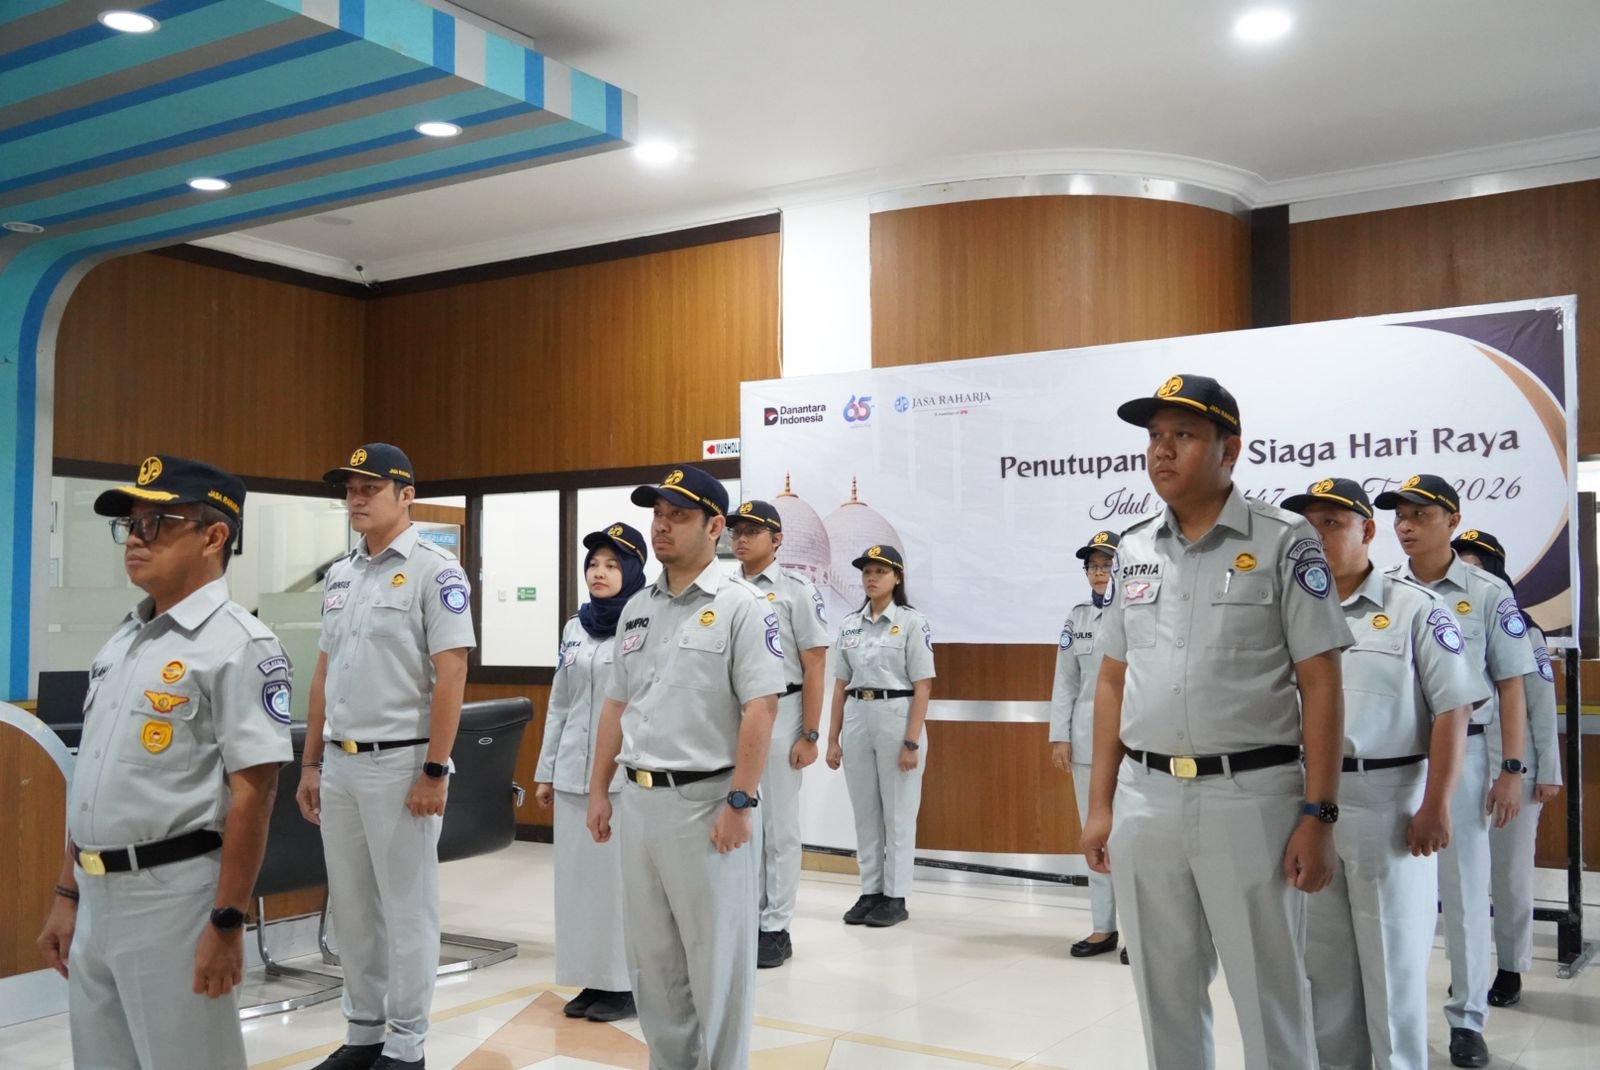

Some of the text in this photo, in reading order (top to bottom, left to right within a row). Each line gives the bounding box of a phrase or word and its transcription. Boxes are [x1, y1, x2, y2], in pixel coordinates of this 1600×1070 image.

[842, 394, 873, 423] 65
[912, 391, 992, 409] JASA RAHARJA
[780, 404, 826, 415] Danantara
[780, 413, 823, 425] Indonesia
[1000, 427, 1521, 479] Penutupan Siaga Hari Raya
[1089, 487, 1151, 520] Idul
[1453, 475, 1522, 501] 2026
[1122, 564, 1159, 579] SATRIA
